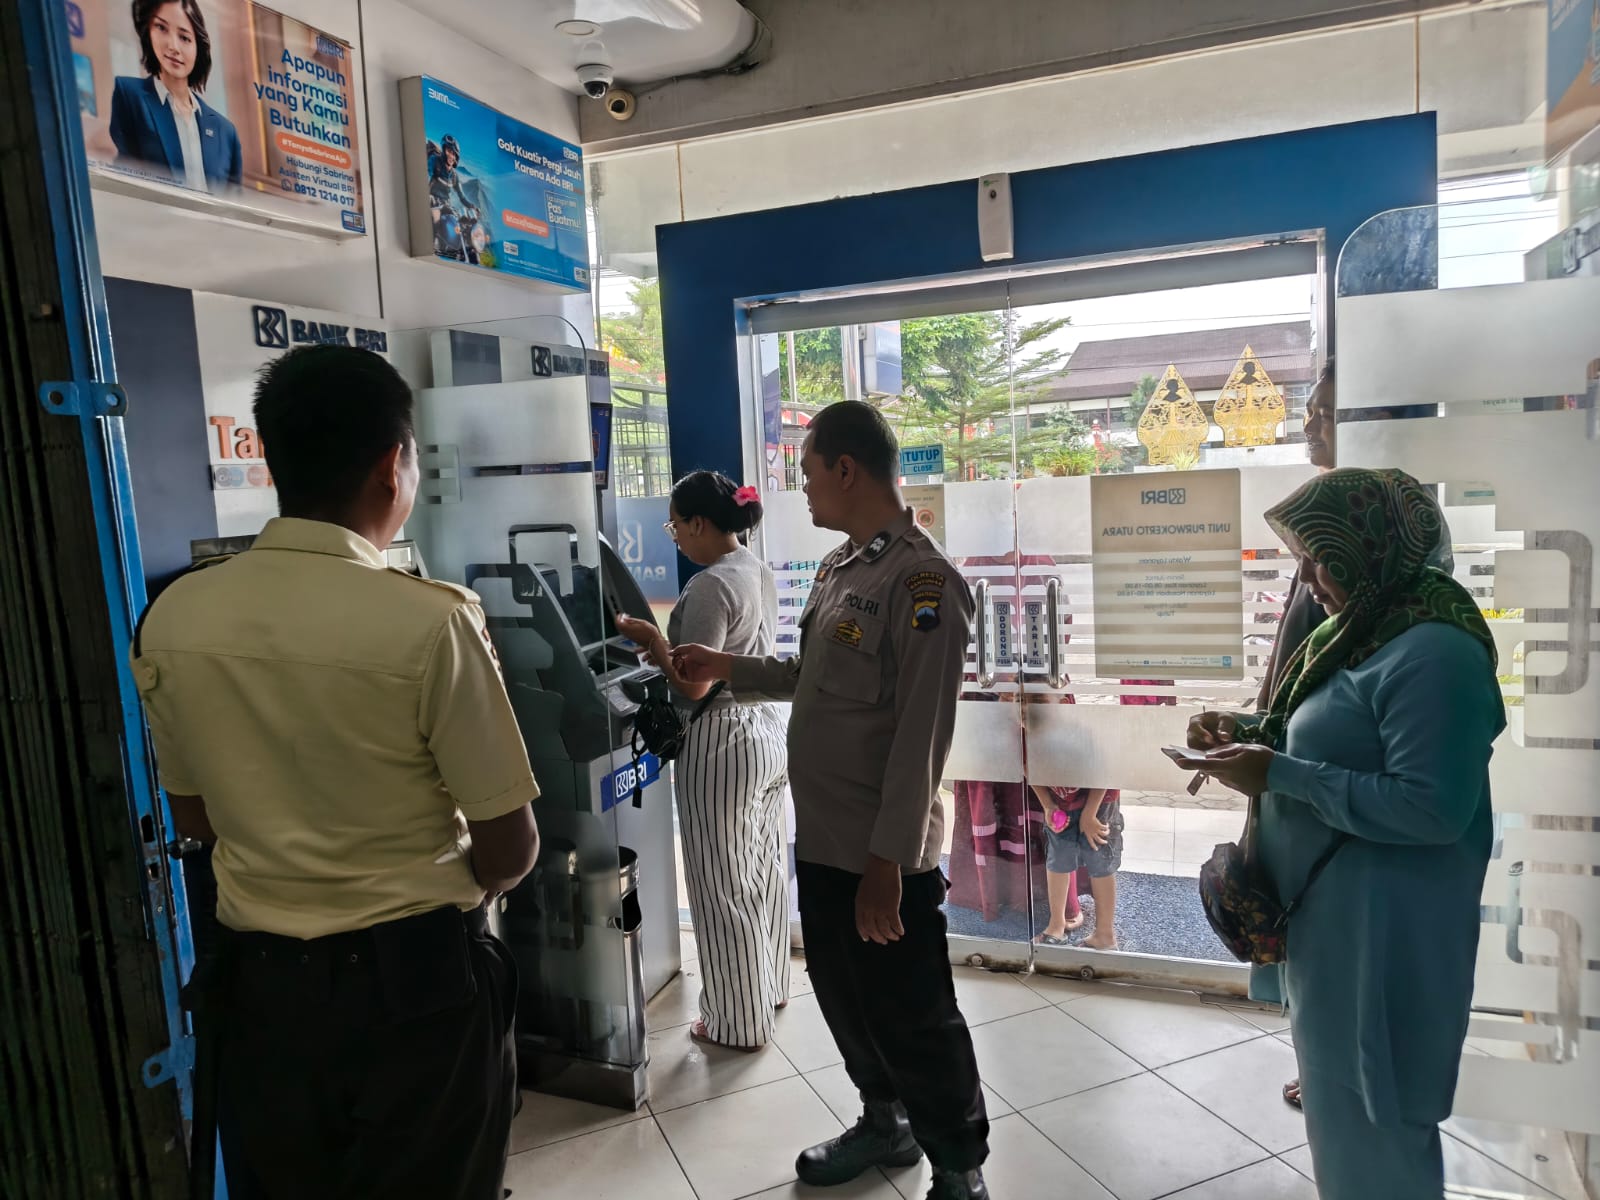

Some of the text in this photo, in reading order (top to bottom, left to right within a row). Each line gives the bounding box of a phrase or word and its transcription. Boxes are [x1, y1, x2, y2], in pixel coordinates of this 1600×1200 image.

[281, 48, 346, 87] Apapun
[267, 64, 348, 110] informasi
[253, 81, 349, 126] yang Kamu
[269, 107, 351, 149] Butuhkan
[286, 155, 354, 183] Hubungi Sabrina
[497, 138, 582, 182] Gak Kuatir Pergi Jauh
[514, 159, 545, 180] Karena
[545, 173, 561, 187] Ada
[294, 182, 355, 207] 0812 1214 017
[312, 175, 341, 190] Virtual
[341, 184, 355, 194] BRI
[547, 201, 562, 214] Pas
[290, 319, 388, 353] BANK BRI
[904, 448, 940, 462] TUTUP
[913, 465, 933, 473] CLOSE
[845, 593, 880, 616] POLRI
[999, 615, 1007, 657] DORONG
[1031, 616, 1040, 657] TARIK
[628, 761, 648, 790] BRI
